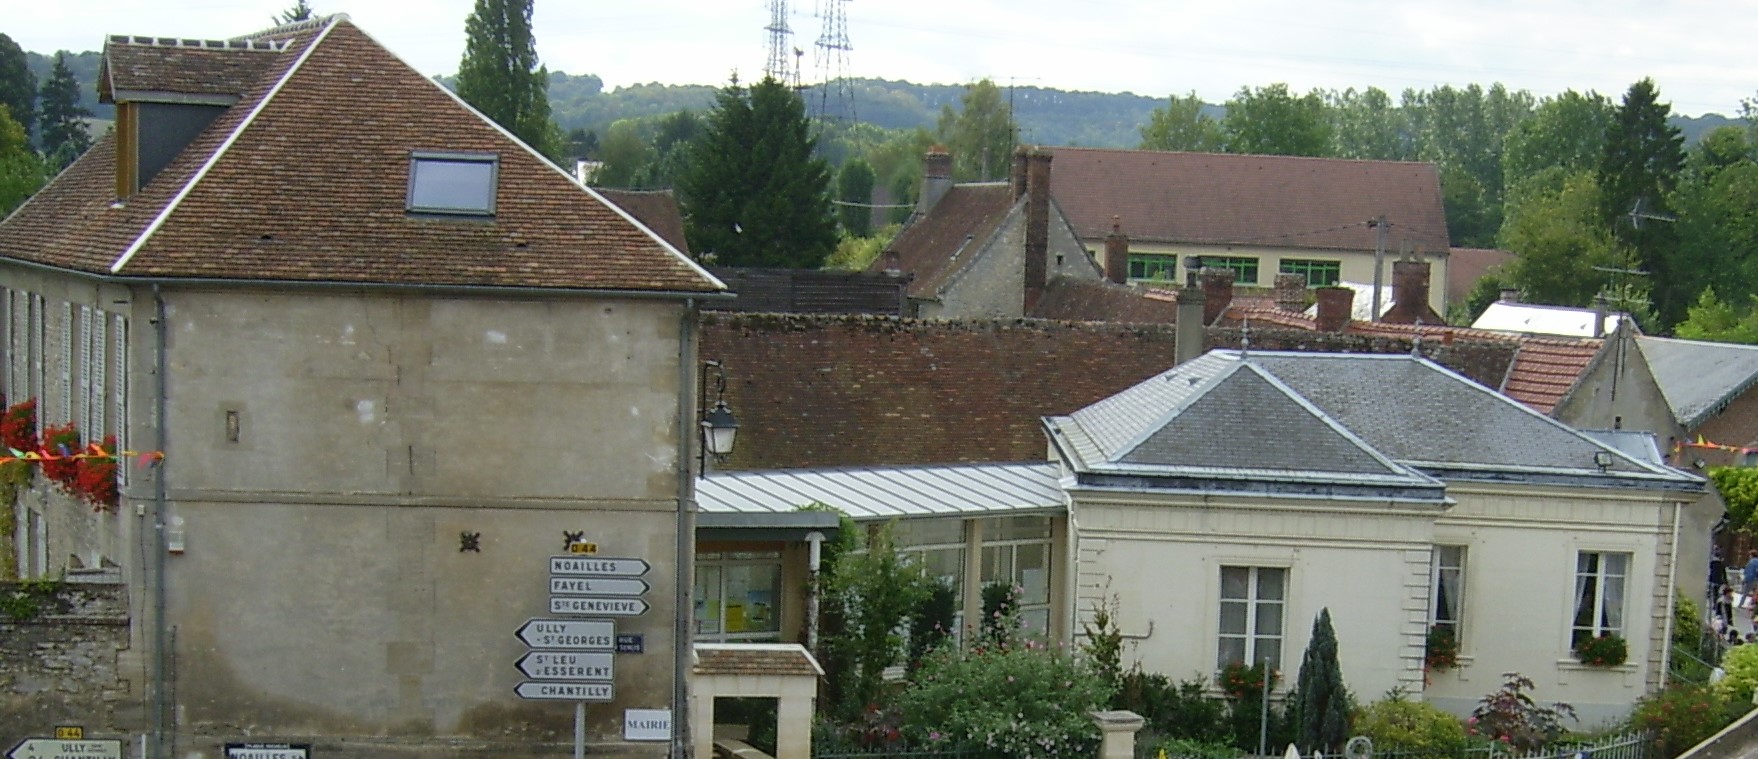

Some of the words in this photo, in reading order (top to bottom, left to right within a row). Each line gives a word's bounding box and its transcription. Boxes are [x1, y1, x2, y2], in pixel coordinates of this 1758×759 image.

[582, 543, 597, 553] 44
[554, 561, 616, 572] NOAILLES
[554, 580, 592, 591] FAYEL
[572, 601, 635, 612] GENEVIEVE
[536, 624, 566, 633] ULLY
[557, 635, 611, 646] GEORGES
[553, 655, 577, 665] LEU
[541, 686, 609, 697] CHANTILLY
[628, 720, 668, 730] MAIRIE
[62, 743, 86, 753] ULLY
